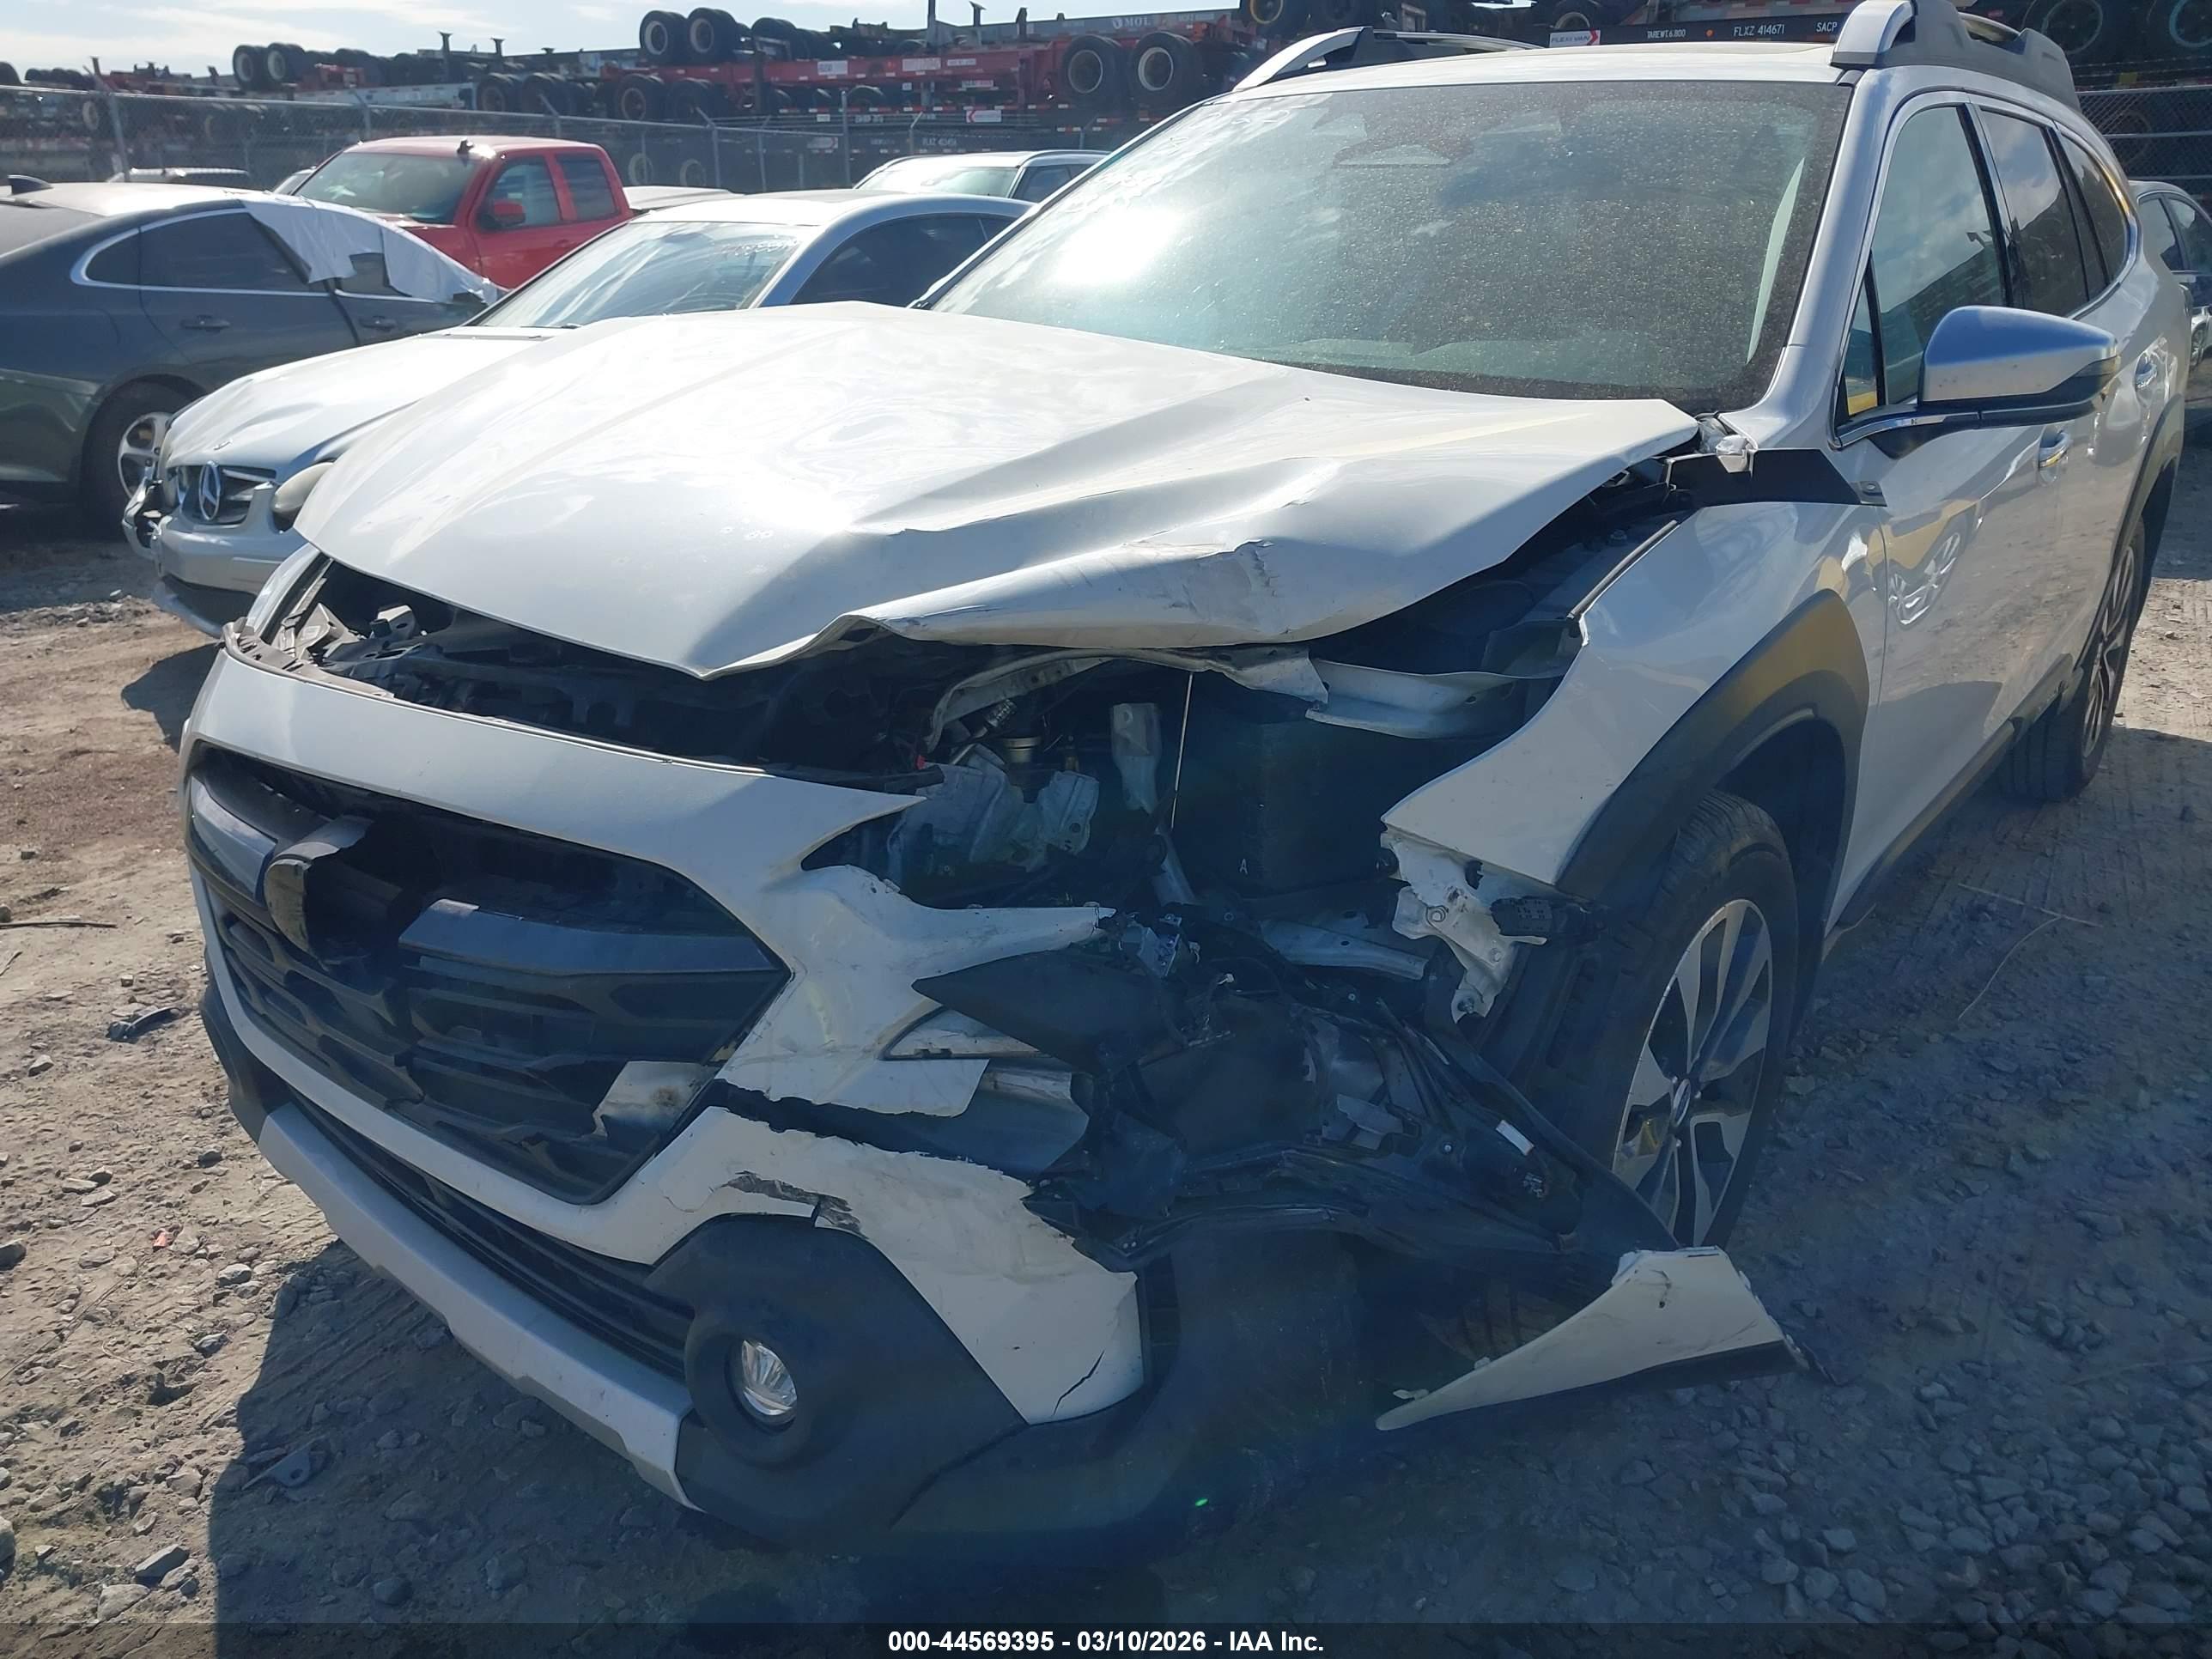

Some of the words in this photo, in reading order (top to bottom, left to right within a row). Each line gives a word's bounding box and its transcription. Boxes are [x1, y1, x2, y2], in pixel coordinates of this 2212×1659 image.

[1734, 26, 1755, 36] FLXZ
[1757, 24, 1784, 35] 414671
[1816, 21, 1838, 33] SACP
